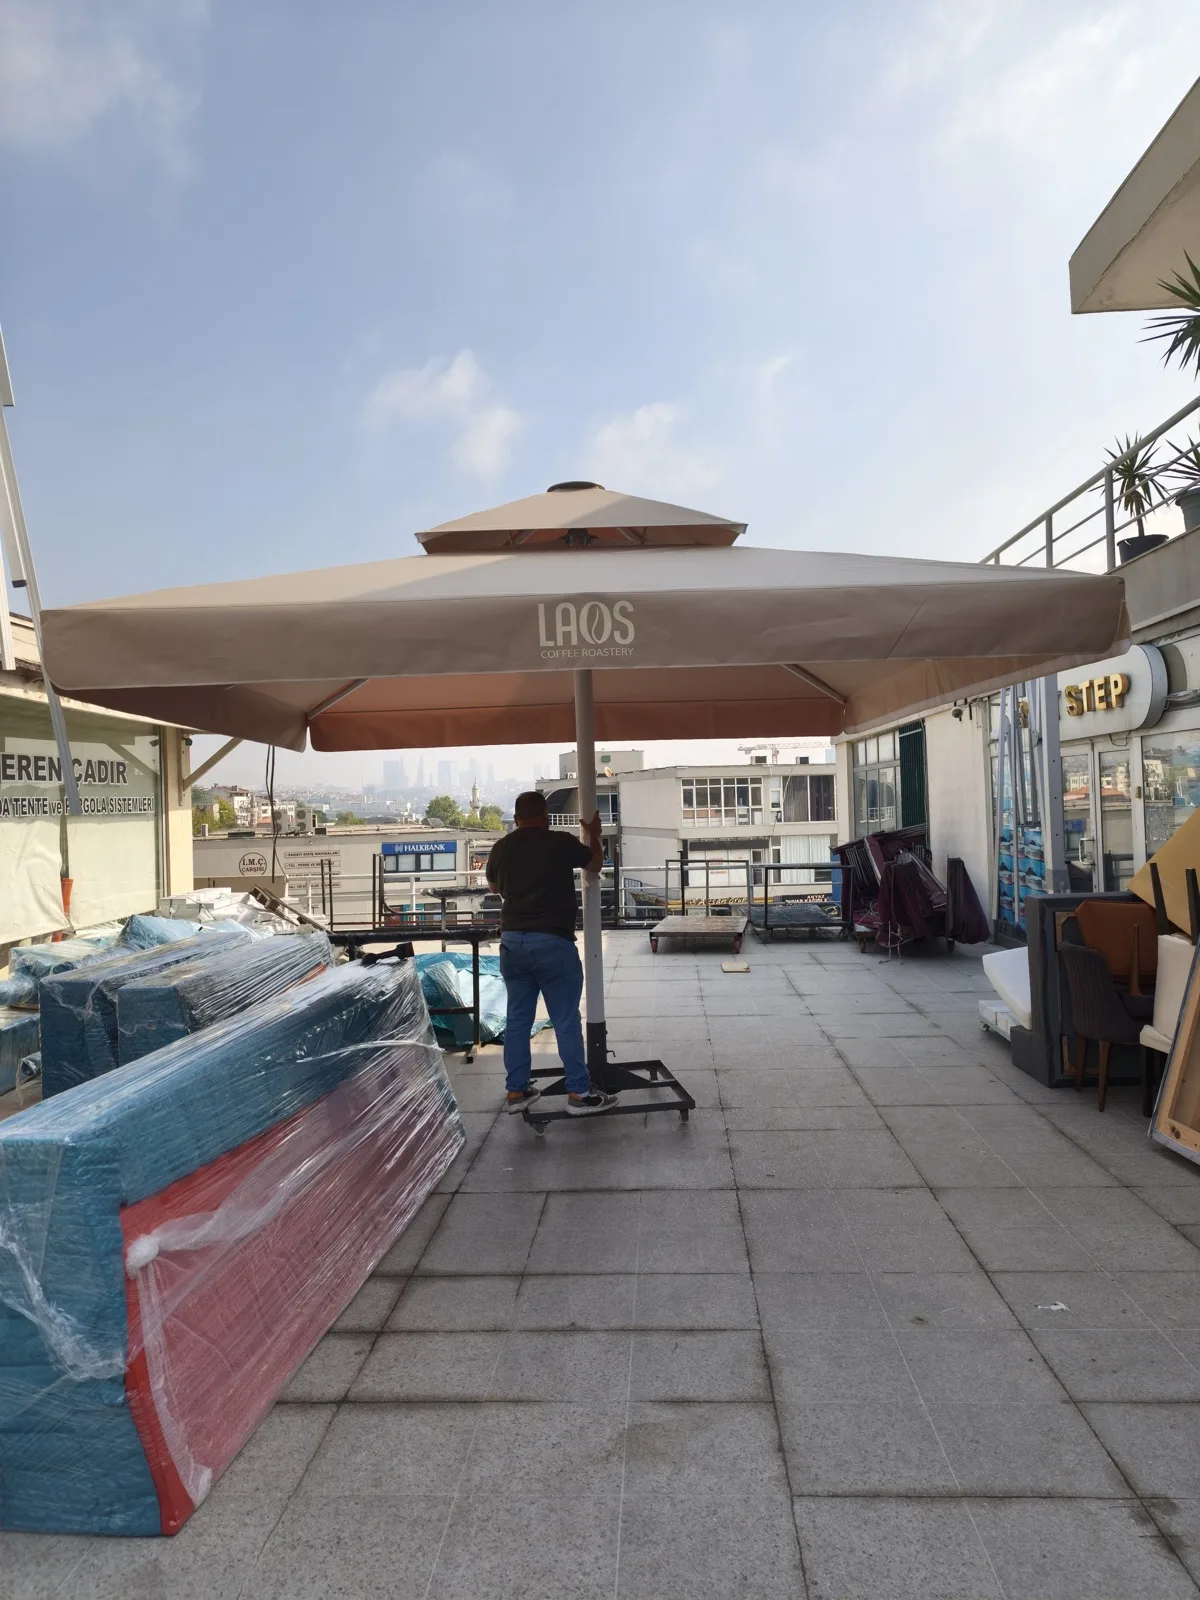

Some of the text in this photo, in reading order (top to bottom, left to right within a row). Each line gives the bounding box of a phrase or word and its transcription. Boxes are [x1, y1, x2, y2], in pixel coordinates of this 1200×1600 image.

[538, 600, 635, 647] LAOS
[540, 647, 634, 659] COFFEE ROASTERY
[1064, 673, 1128, 717] STEP
[71, 757, 128, 789] ÇADIR
[14, 797, 48, 815] TENTE
[51, 801, 62, 814] ve
[109, 794, 155, 813] SİSTEMLERİ
[404, 843, 446, 852] HALKBANK
